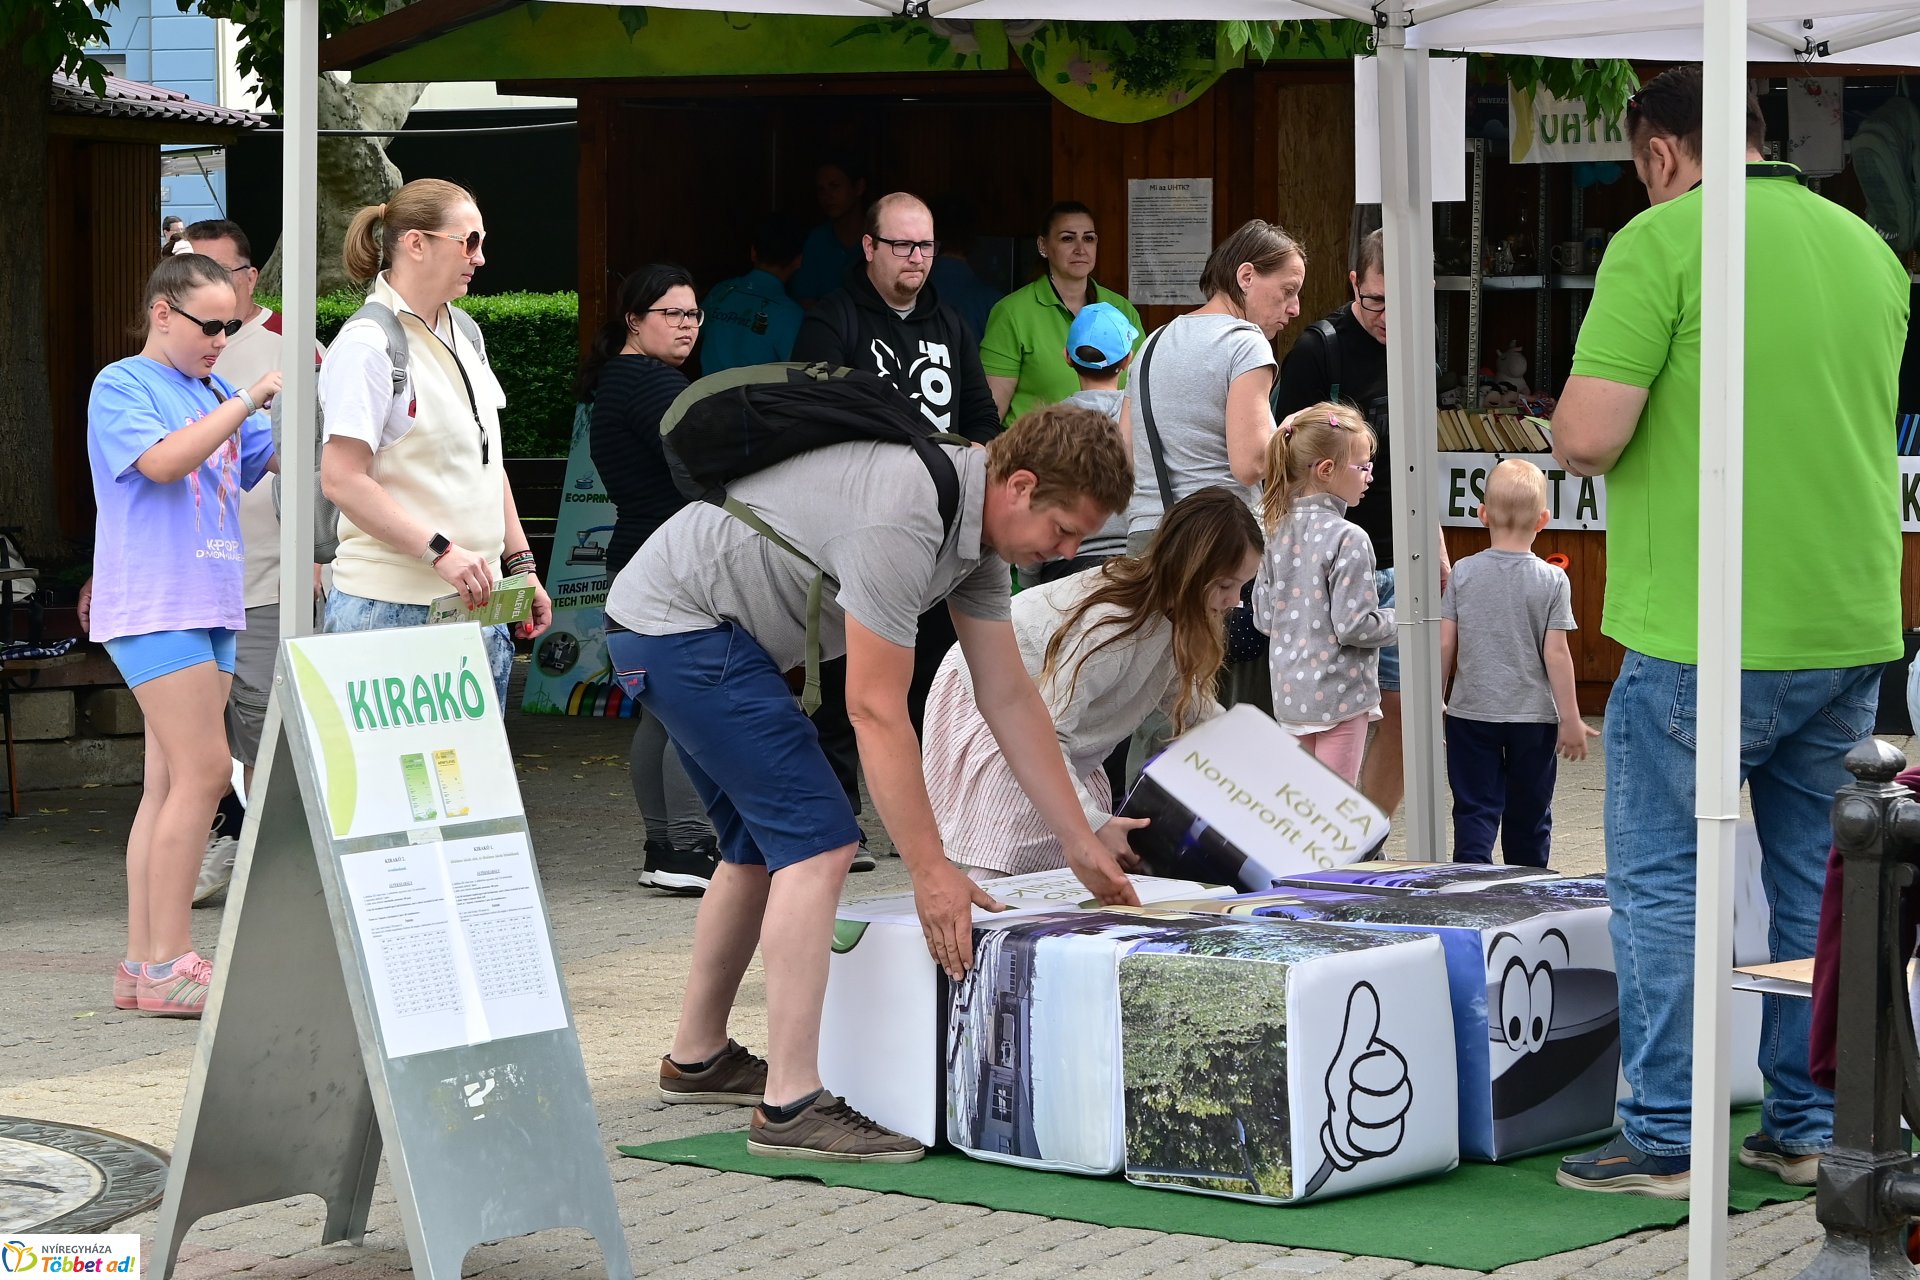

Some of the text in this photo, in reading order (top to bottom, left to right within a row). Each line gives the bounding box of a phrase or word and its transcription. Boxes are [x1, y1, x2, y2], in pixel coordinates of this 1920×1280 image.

[1540, 113, 1623, 144] UHTK
[918, 339, 952, 434] FOX
[1576, 476, 1599, 521] A
[553, 593, 608, 608] TECH TOMO
[557, 583, 588, 595] TRASH
[346, 655, 486, 731] KIRAKÓ
[1183, 750, 1303, 845] Nonprofit
[1274, 782, 1357, 853] Körny
